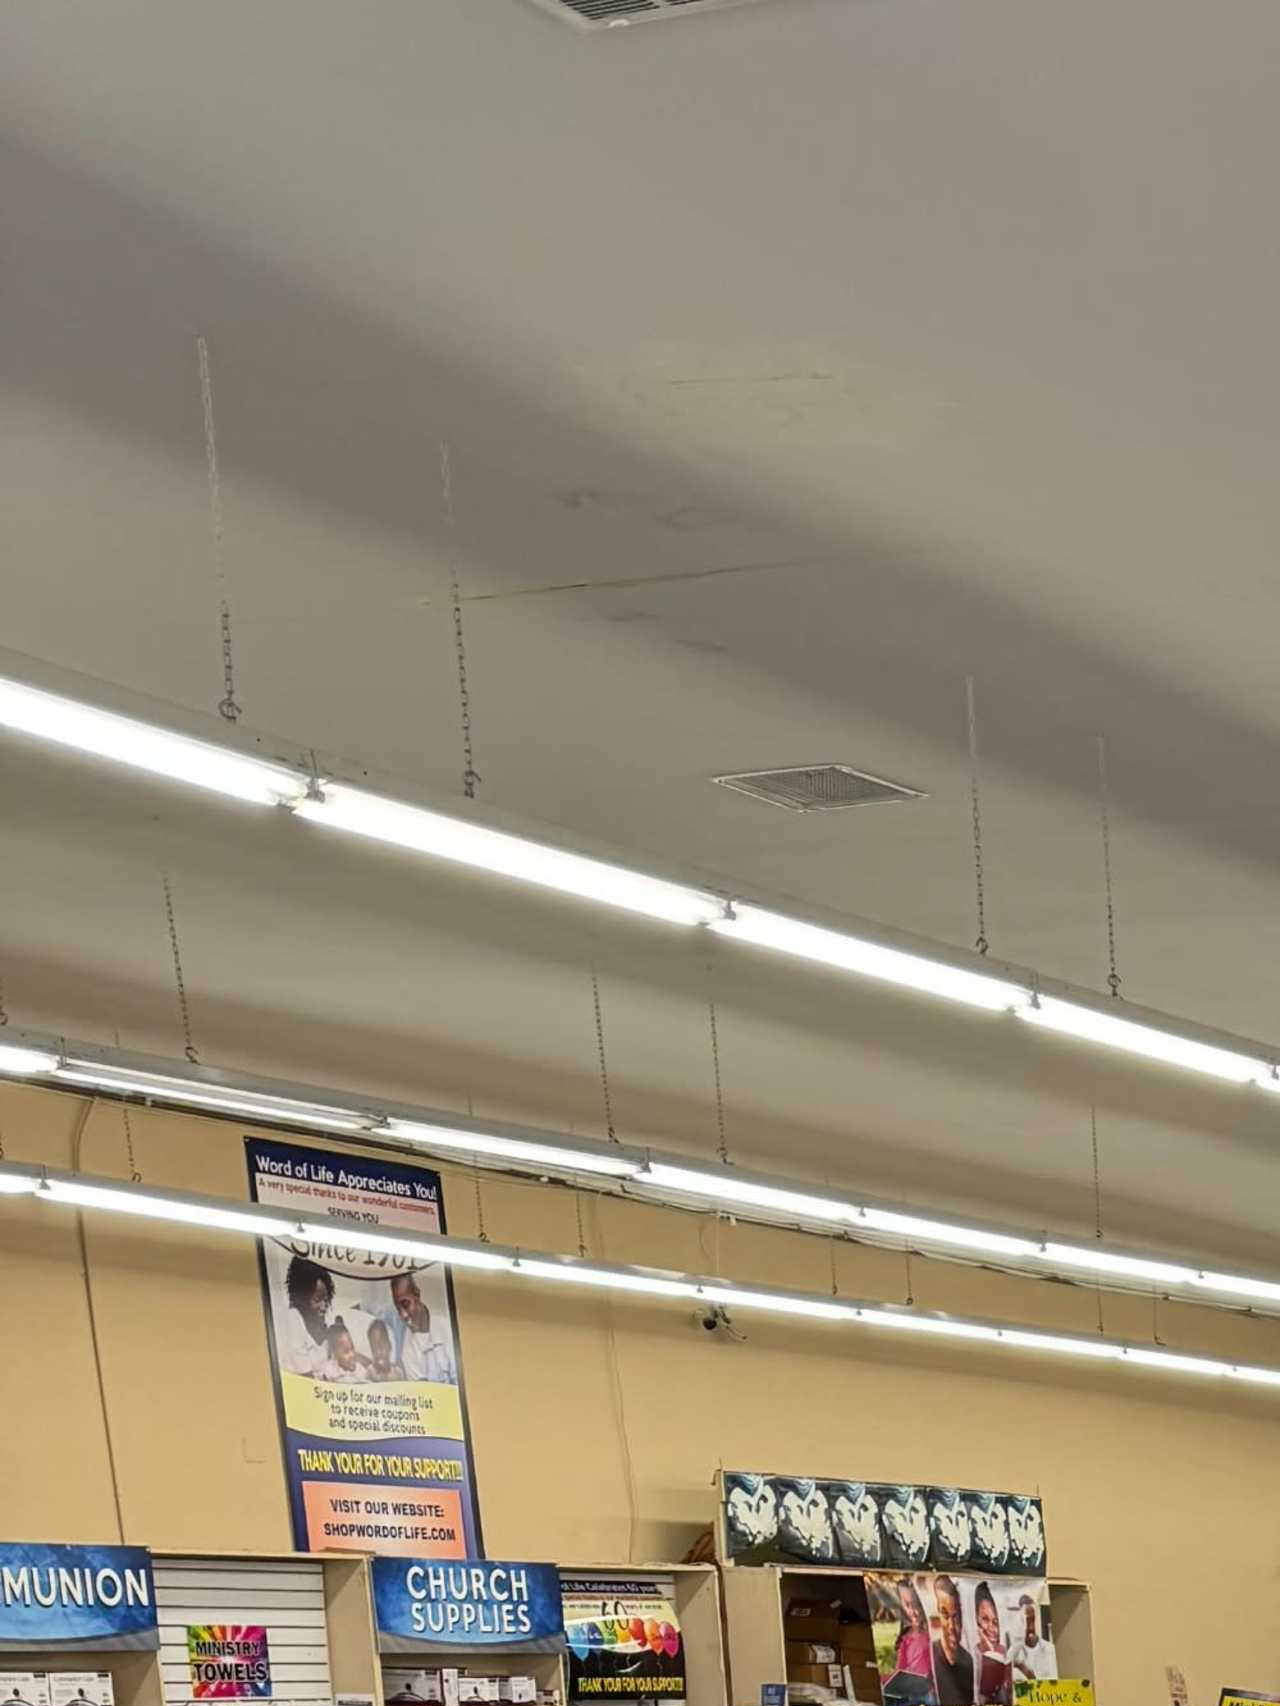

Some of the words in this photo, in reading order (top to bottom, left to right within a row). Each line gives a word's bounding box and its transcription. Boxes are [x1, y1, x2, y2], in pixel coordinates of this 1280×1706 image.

[256, 1155, 292, 1175] Word
[295, 1163, 307, 1178] of
[311, 1165, 333, 1183] Life
[338, 1170, 411, 1196] Appreciates
[413, 1182, 437, 1200] You!
[286, 1182, 311, 1196] special
[362, 1213, 379, 1224] YOU
[314, 1386, 334, 1403] Sign
[336, 1390, 348, 1403] up
[350, 1389, 364, 1402] for
[367, 1393, 382, 1404] our
[384, 1394, 417, 1410] mailing
[419, 1396, 433, 1409] list
[332, 1404, 341, 1414] to
[344, 1406, 379, 1418] receive
[382, 1409, 420, 1422] coupons
[329, 1417, 345, 1428] and
[348, 1418, 380, 1432] special
[383, 1421, 426, 1435] discounts
[298, 1449, 335, 1473] THANK
[336, 1452, 363, 1475] YOUR
[364, 1454, 385, 1476] FOR
[386, 1456, 413, 1477] YOUR
[330, 1499, 360, 1513] VISIT
[365, 1501, 389, 1515] OUR
[392, 1503, 444, 1518] WEBSITE:
[324, 1523, 456, 1541] SHOPWORDOFLIFE.COM
[406, 1565, 529, 1601] CHURCH
[412, 1603, 532, 1634] SUPPLIES
[196, 1641, 261, 1657] MINISTRY
[195, 1663, 268, 1682] TOWELS
[578, 1676, 602, 1692] THANK
[1028, 1691, 1068, 1704] Hope
[1073, 1692, 1082, 1703] &
